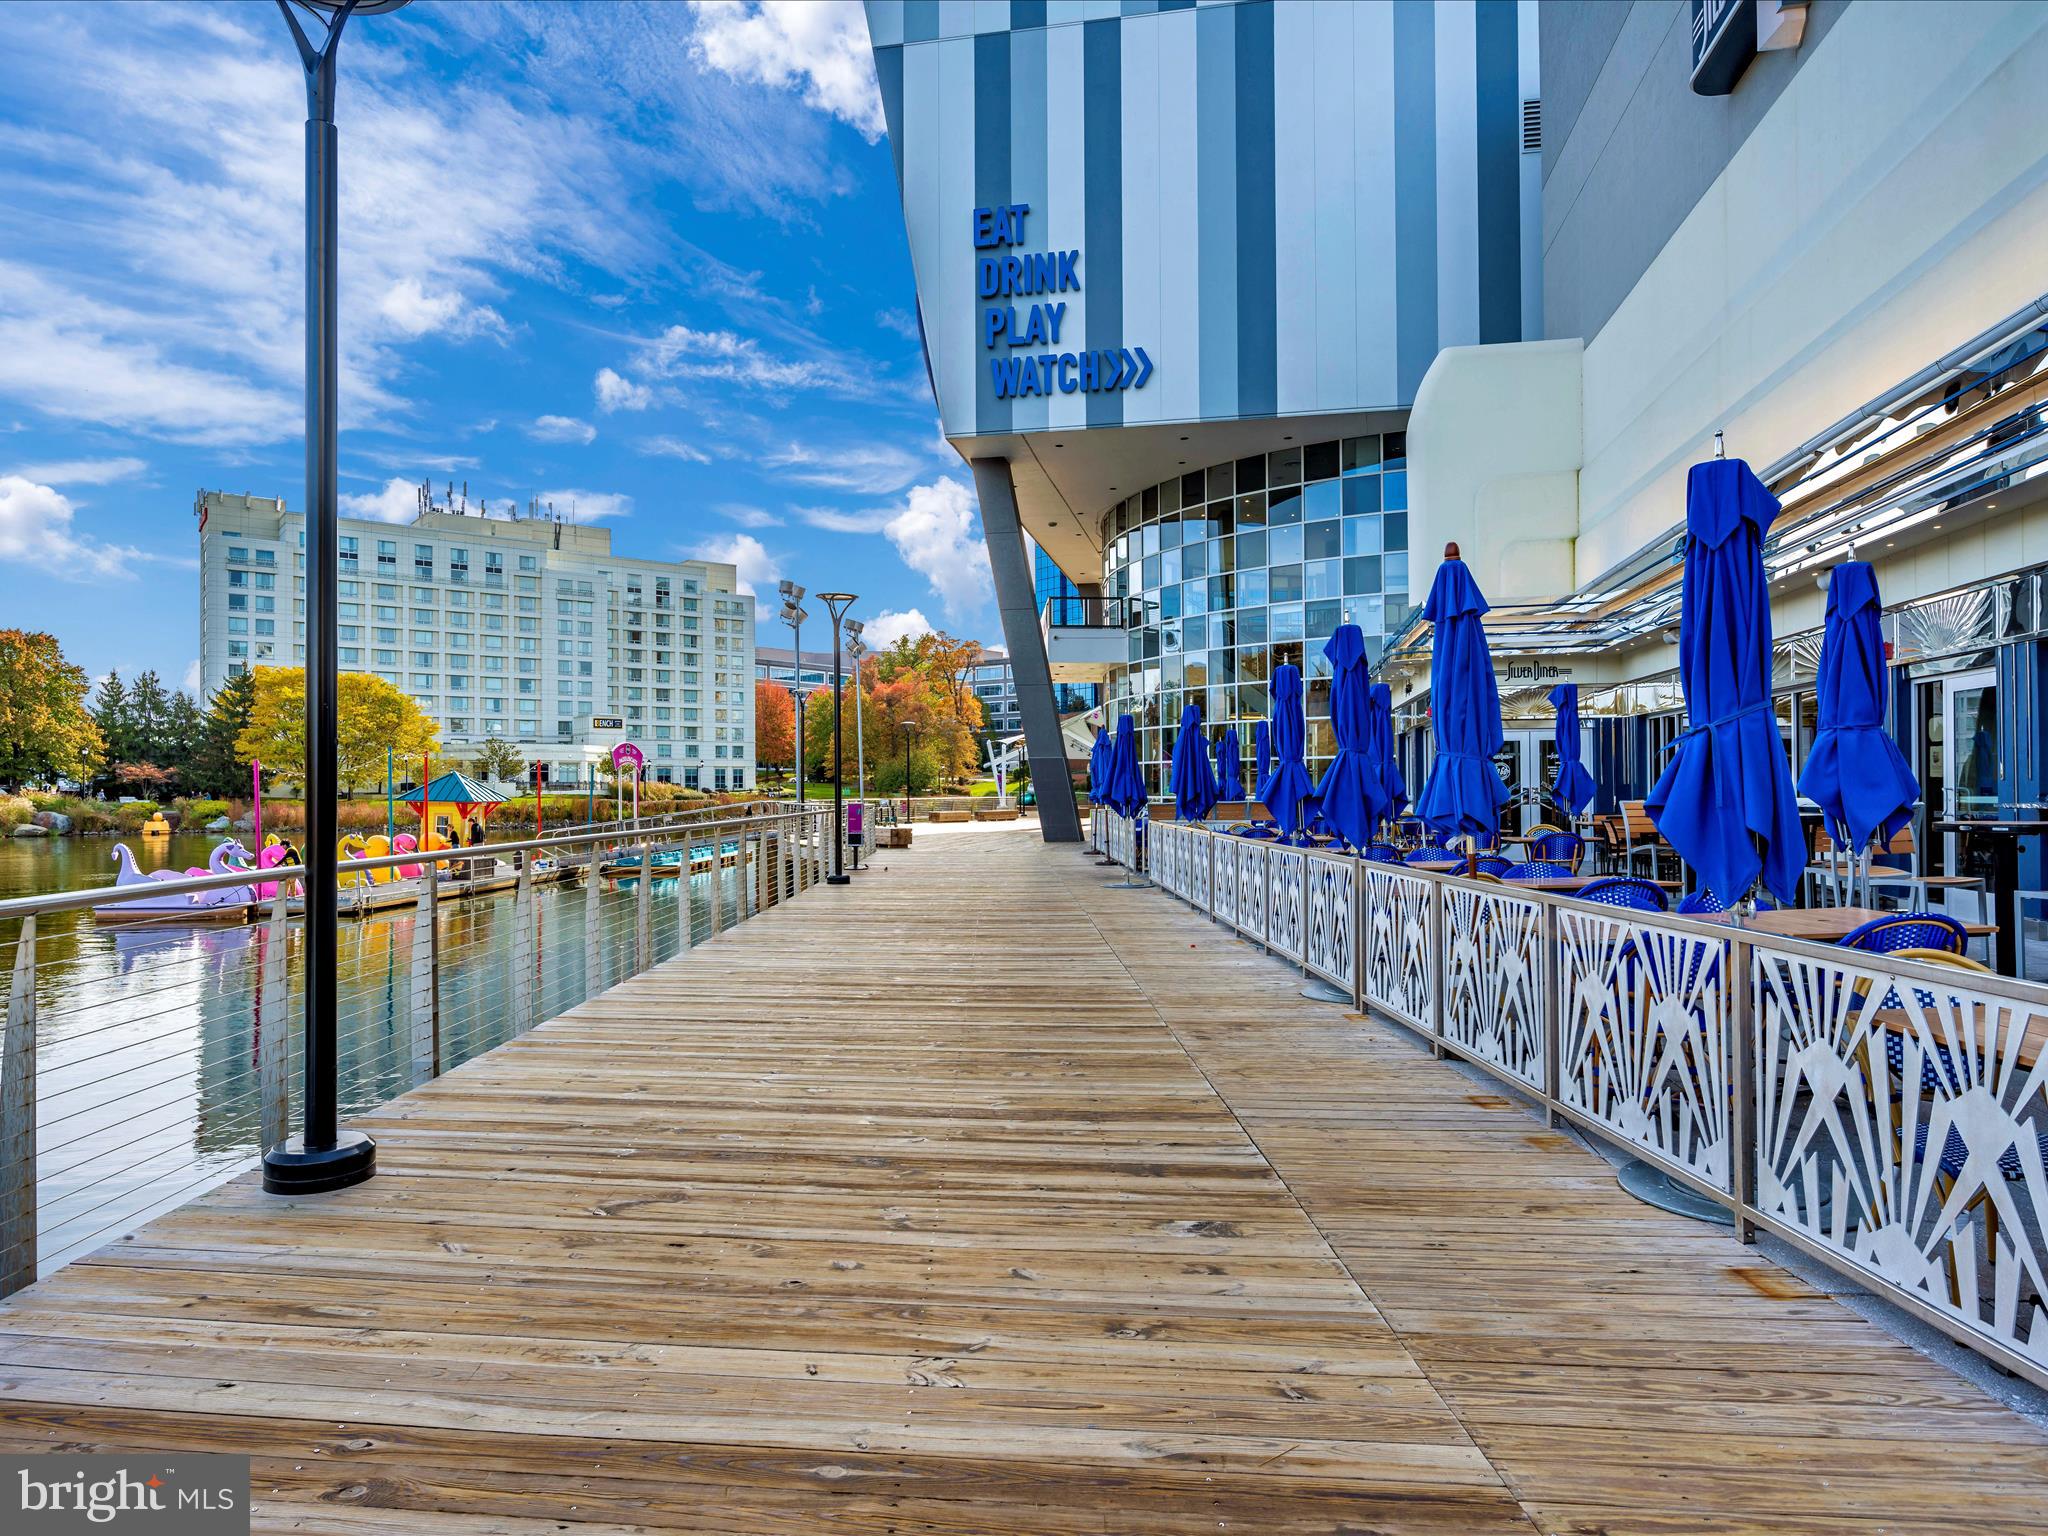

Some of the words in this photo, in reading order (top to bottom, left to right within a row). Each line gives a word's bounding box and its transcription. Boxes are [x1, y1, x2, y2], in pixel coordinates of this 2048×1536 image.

[973, 203, 1030, 249] EAT
[979, 250, 1081, 299] DRINK
[985, 302, 1066, 349] PLAY
[991, 351, 1101, 399] WATCH
